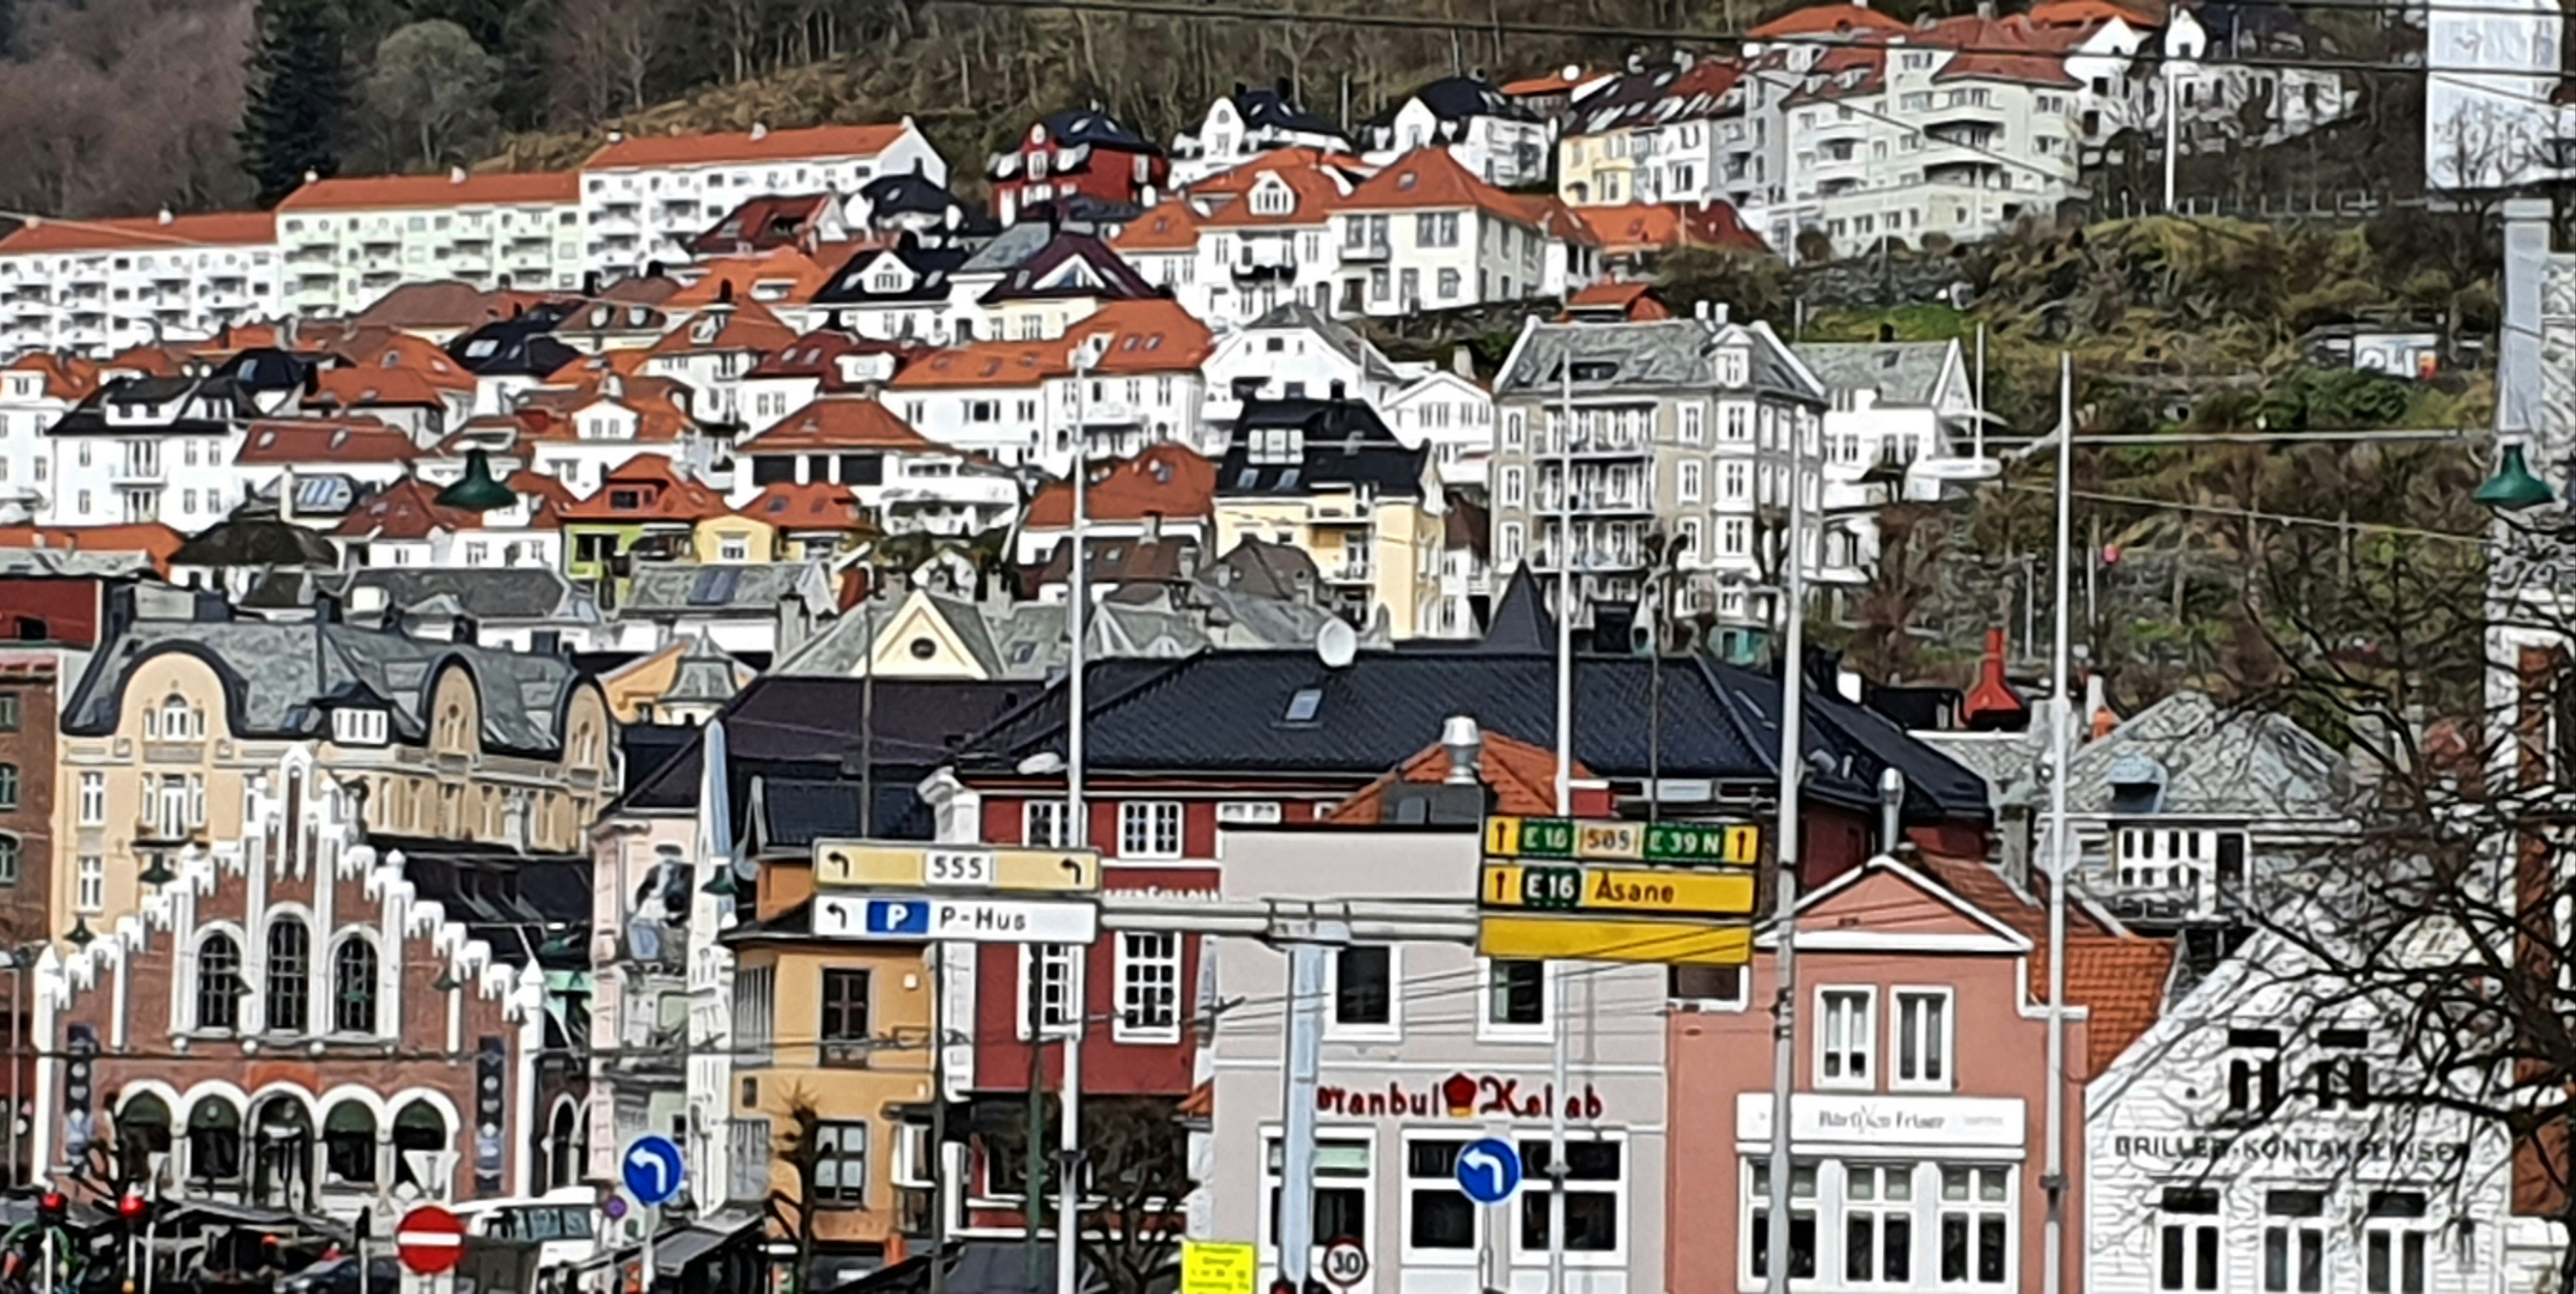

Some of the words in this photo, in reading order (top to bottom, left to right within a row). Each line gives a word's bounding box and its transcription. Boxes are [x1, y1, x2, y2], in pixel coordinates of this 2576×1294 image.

[1524, 826, 1539, 848] E
[1648, 830, 1664, 852] E
[1669, 832, 1697, 853] 39
[1702, 834, 1720, 855] N
[932, 855, 983, 880] 555
[1526, 874, 1542, 898] E
[1549, 875, 1575, 899] 16
[1595, 869, 1675, 903] Åsane
[886, 904, 909, 928] P
[938, 906, 1027, 930] P-Hus
[1317, 1081, 1440, 1117] stanbul
[1332, 1251, 1361, 1275] 30
